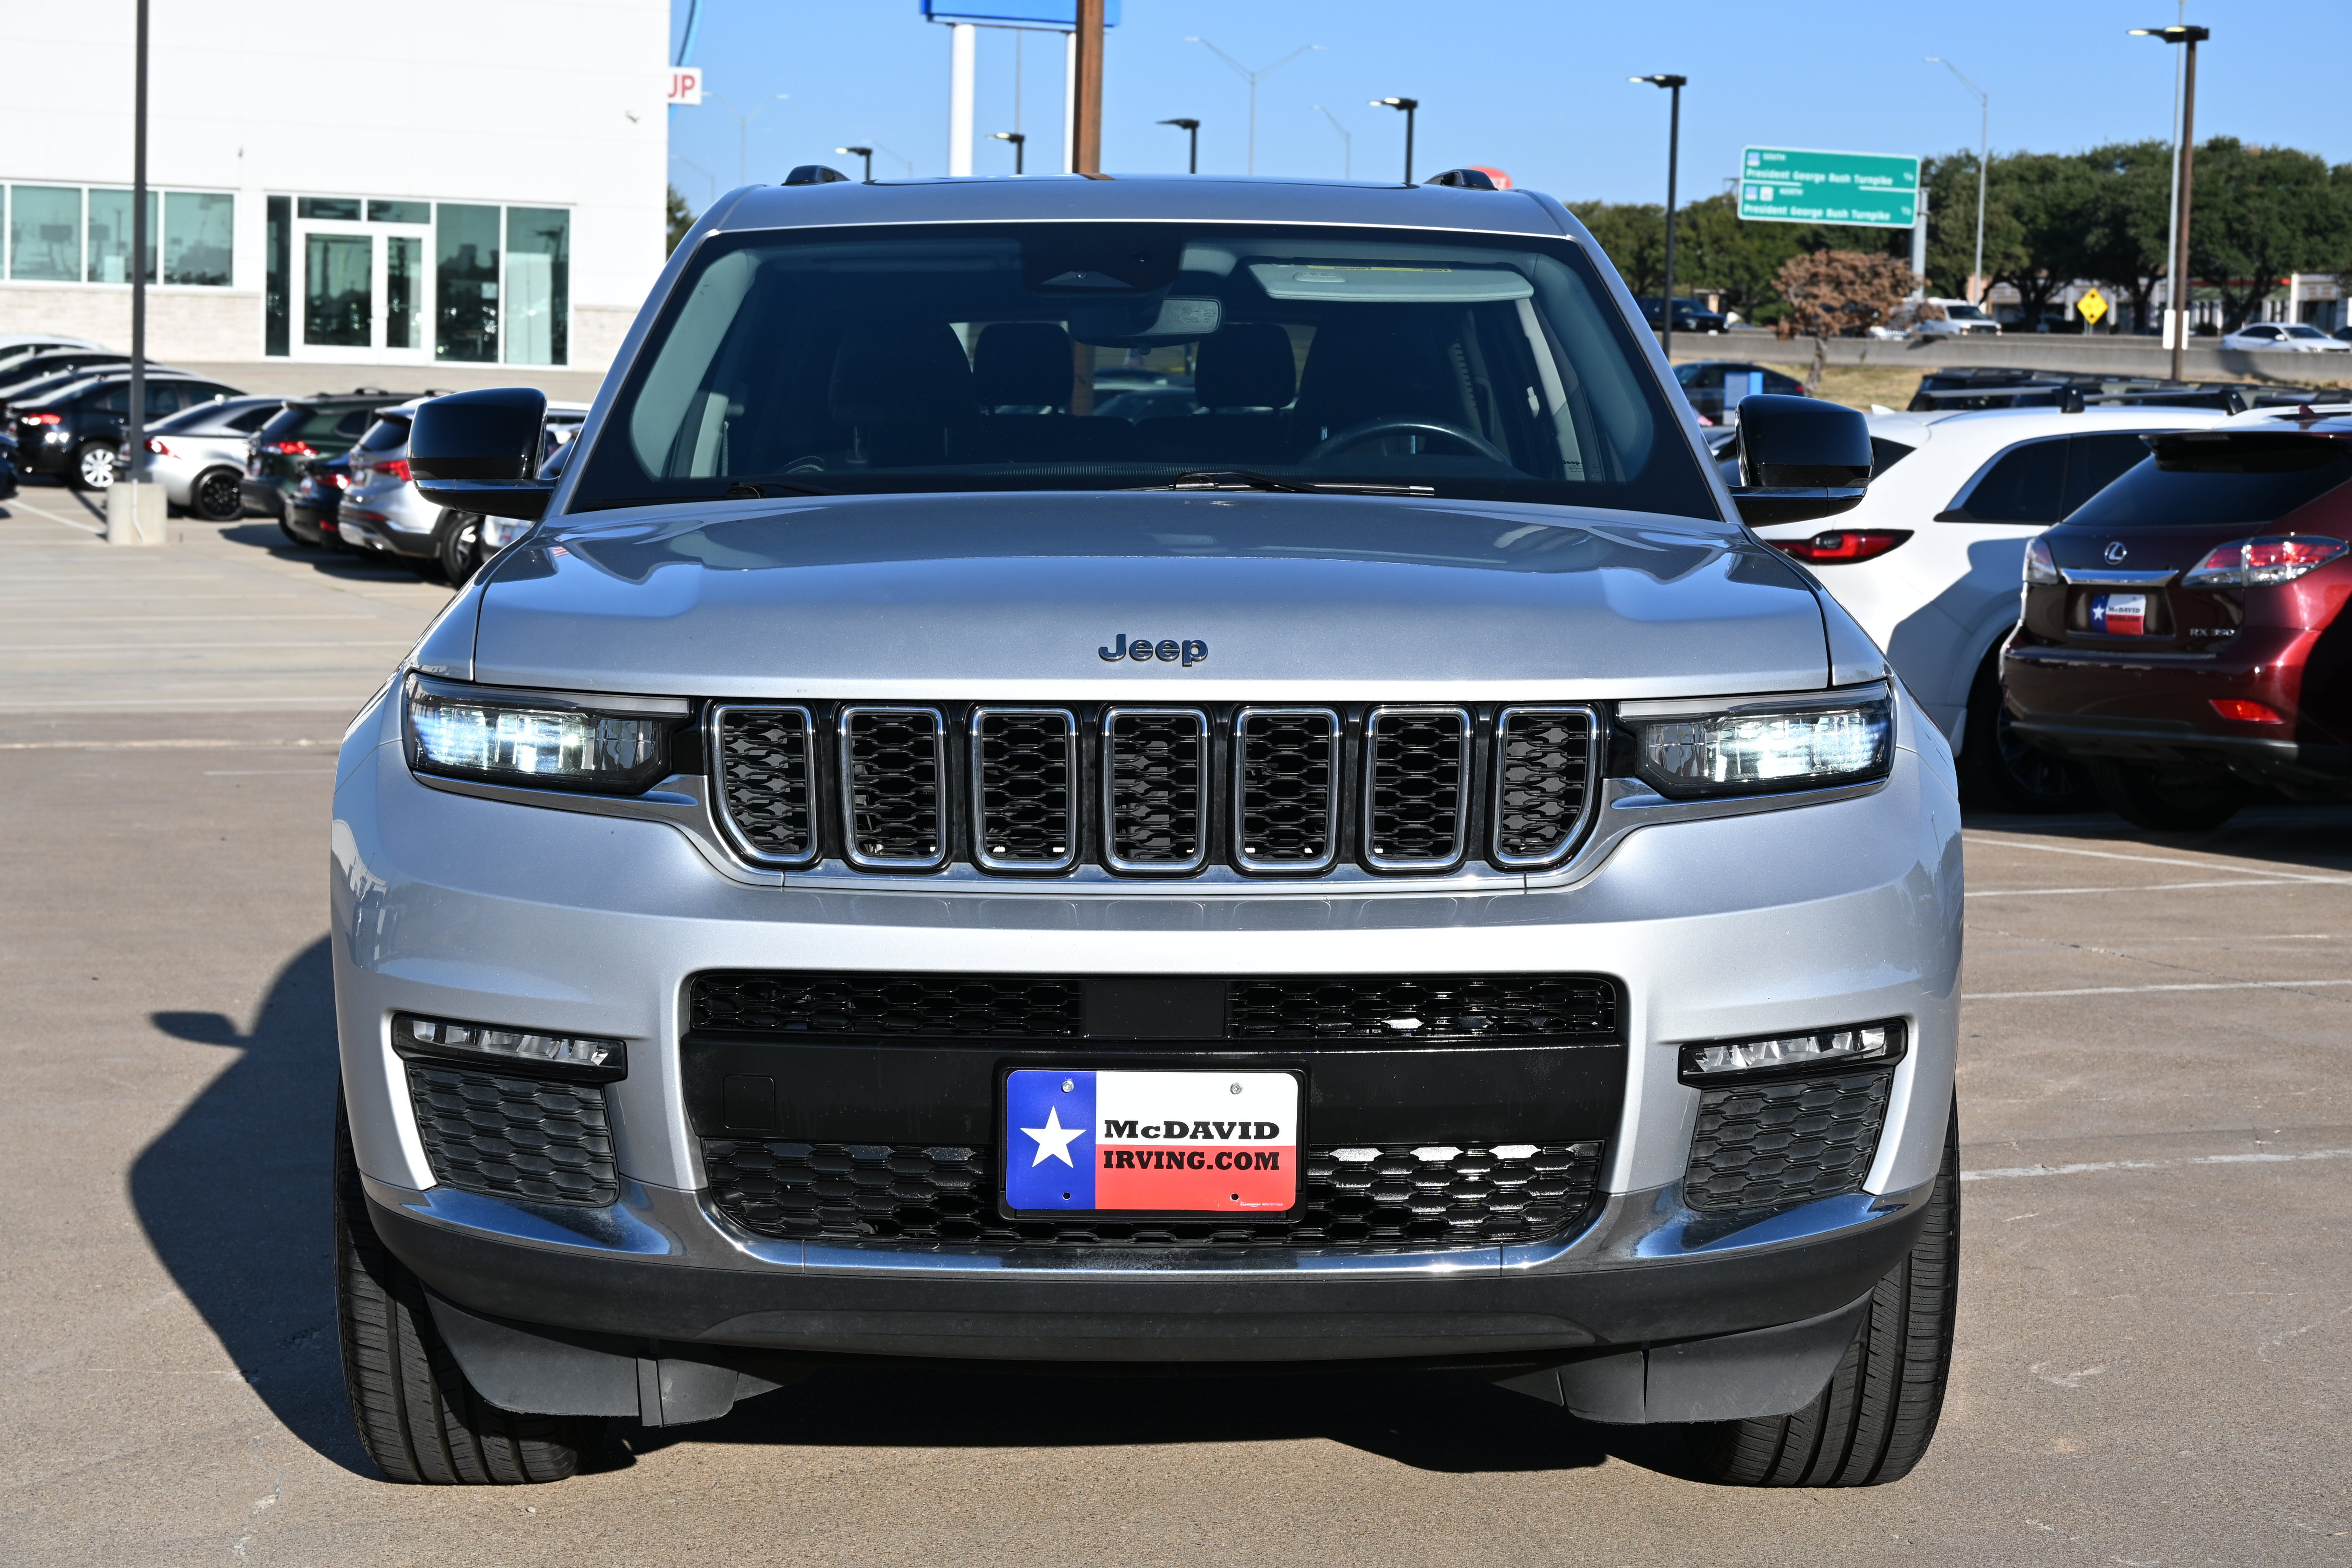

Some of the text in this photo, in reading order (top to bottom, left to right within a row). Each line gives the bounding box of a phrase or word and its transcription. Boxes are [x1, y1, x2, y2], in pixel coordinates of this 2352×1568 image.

[1746, 168, 1790, 180] President
[1792, 170, 1826, 184] George
[1828, 172, 1851, 183] Bush
[1853, 174, 1893, 186] Turnpike
[1743, 203, 1788, 215] President
[1790, 206, 1824, 219] George
[1826, 208, 1848, 218] Bush
[1851, 209, 1891, 222] Turnpike
[1099, 634, 1208, 667] Jeep
[1104, 1120, 1280, 1140] McDAVID
[1103, 1151, 1279, 1171] IRVING.COM
